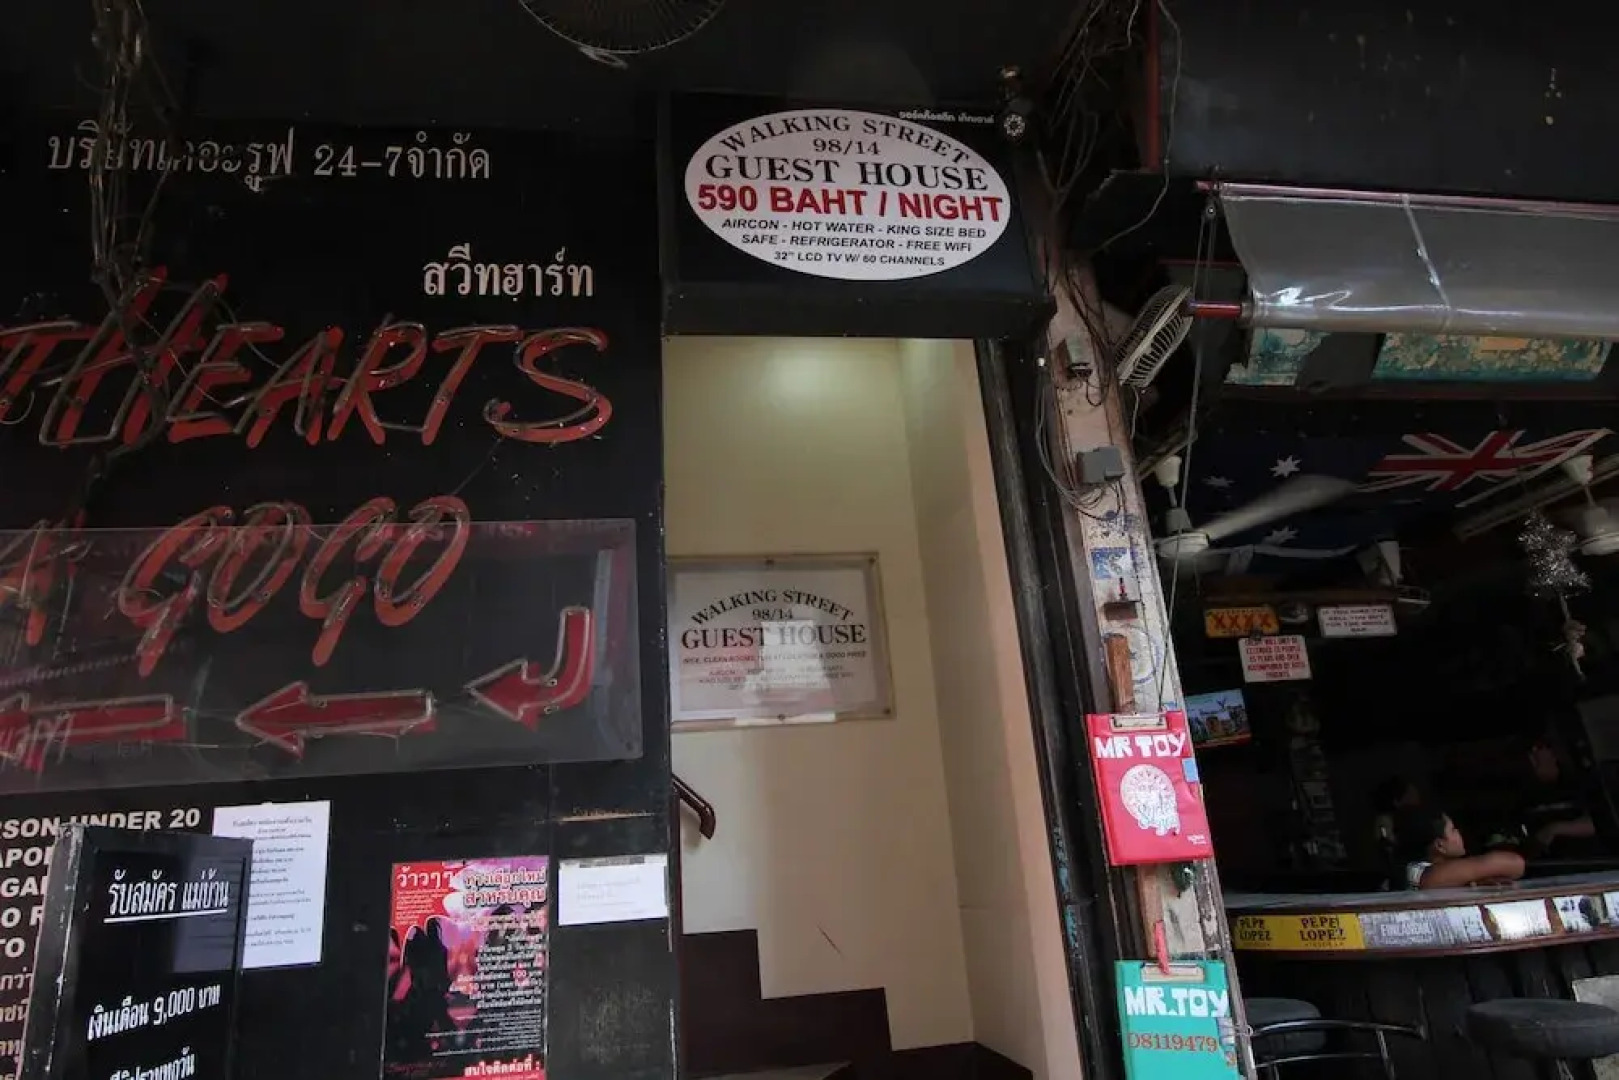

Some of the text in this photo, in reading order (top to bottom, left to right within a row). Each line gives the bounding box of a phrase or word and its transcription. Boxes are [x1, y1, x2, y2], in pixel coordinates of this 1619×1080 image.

[720, 115, 971, 165] WALKING STREET
[812, 137, 881, 156] 98/14
[705, 154, 989, 191] GUEST HOUSE
[697, 184, 757, 212] 590
[770, 186, 868, 216] BAHT
[899, 192, 1003, 223] NIGHT
[722, 218, 780, 231] AIRCON
[791, 220, 821, 232] HOT
[825, 221, 876, 234] WATER
[886, 224, 921, 237] KING
[924, 225, 955, 238] SIZE
[958, 227, 987, 239] BED
[741, 233, 778, 245] SAFE
[789, 235, 896, 249] REFRIGERATOR
[906, 239, 941, 252] FREE
[422, 243, 595, 300] สวีทฮาร์ท
[797, 252, 823, 262] LCD
[826, 253, 842, 263] TV
[879, 255, 946, 267] CHANNELS
[691, 588, 854, 626] WALKING STREET
[752, 608, 794, 621] 98/14
[681, 623, 867, 650] GUEST HOUSE
[1094, 732, 1186, 759] MR TOY
[0, 815, 61, 840] SON
[169, 807, 202, 829] 20
[108, 868, 178, 916] รับสมัคร
[1301, 916, 1340, 929] PEPE
[153, 985, 196, 1027] 9,000
